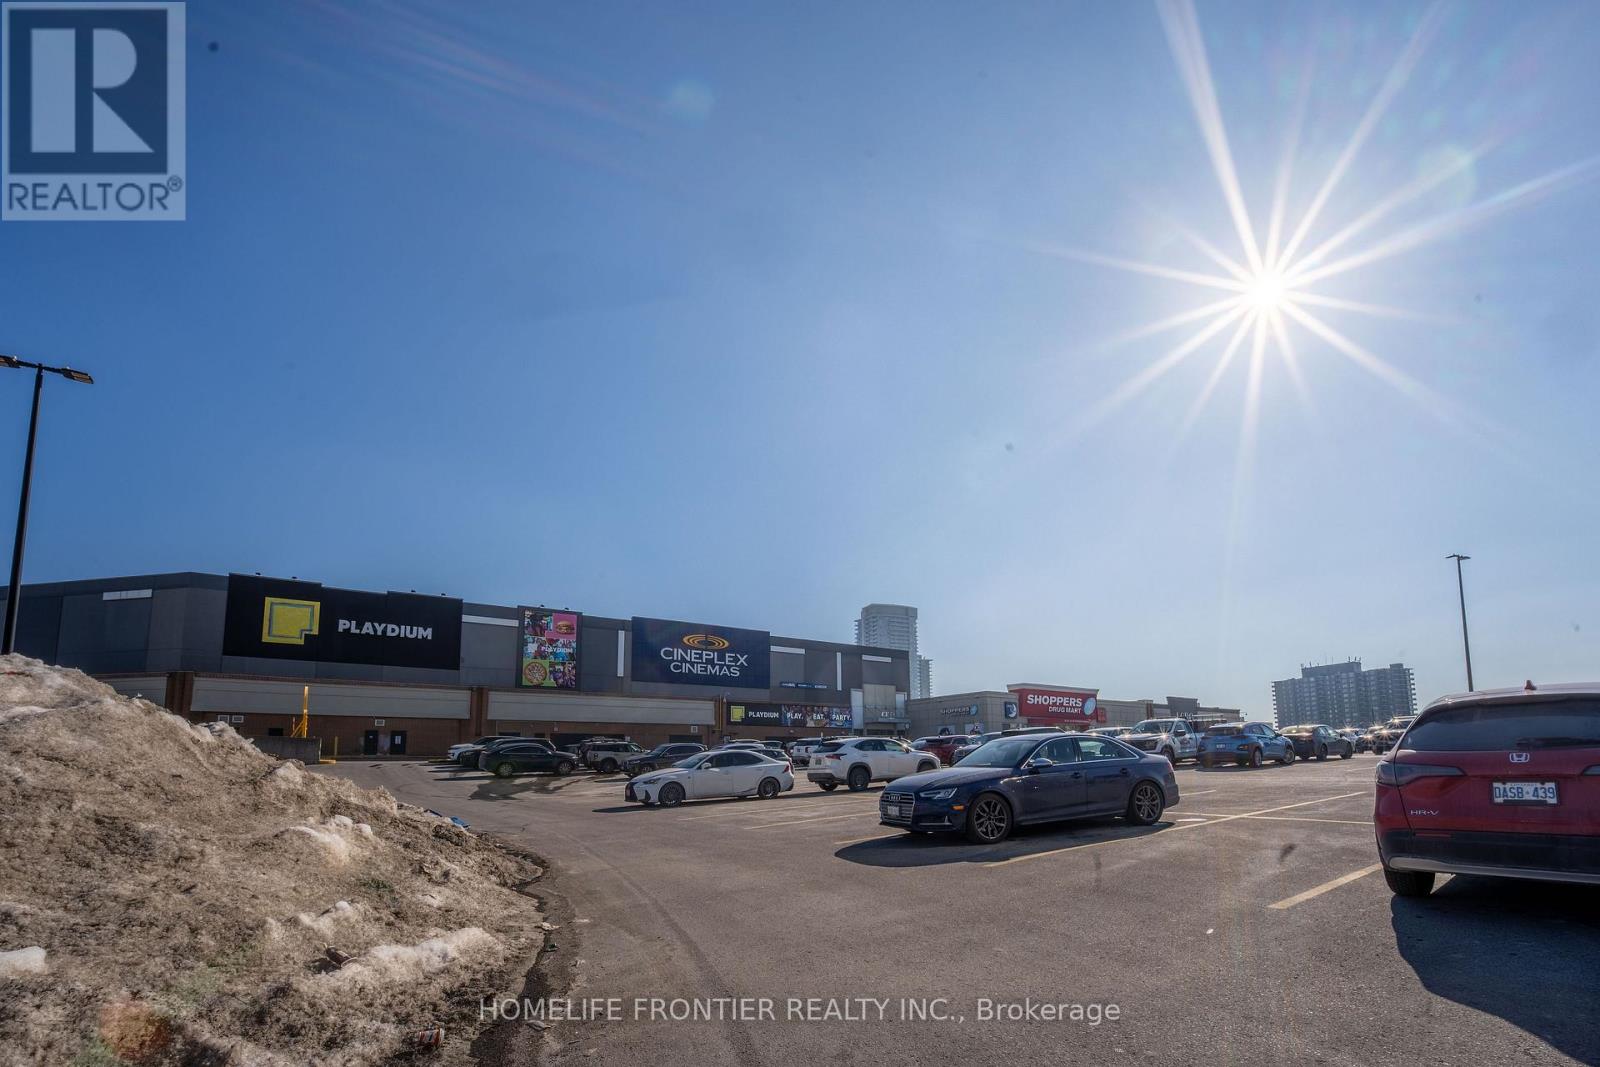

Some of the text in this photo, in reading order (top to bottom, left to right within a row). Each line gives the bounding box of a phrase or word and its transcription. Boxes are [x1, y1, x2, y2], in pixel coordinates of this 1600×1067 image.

[338, 619, 432, 640] PLAYDIUM
[541, 645, 573, 653] PLAYDIUM
[660, 647, 748, 666] CINEPLEX
[670, 662, 740, 677] CINEMAS
[1026, 694, 1082, 707] SHOPPERS
[786, 712, 804, 720] PLAY.
